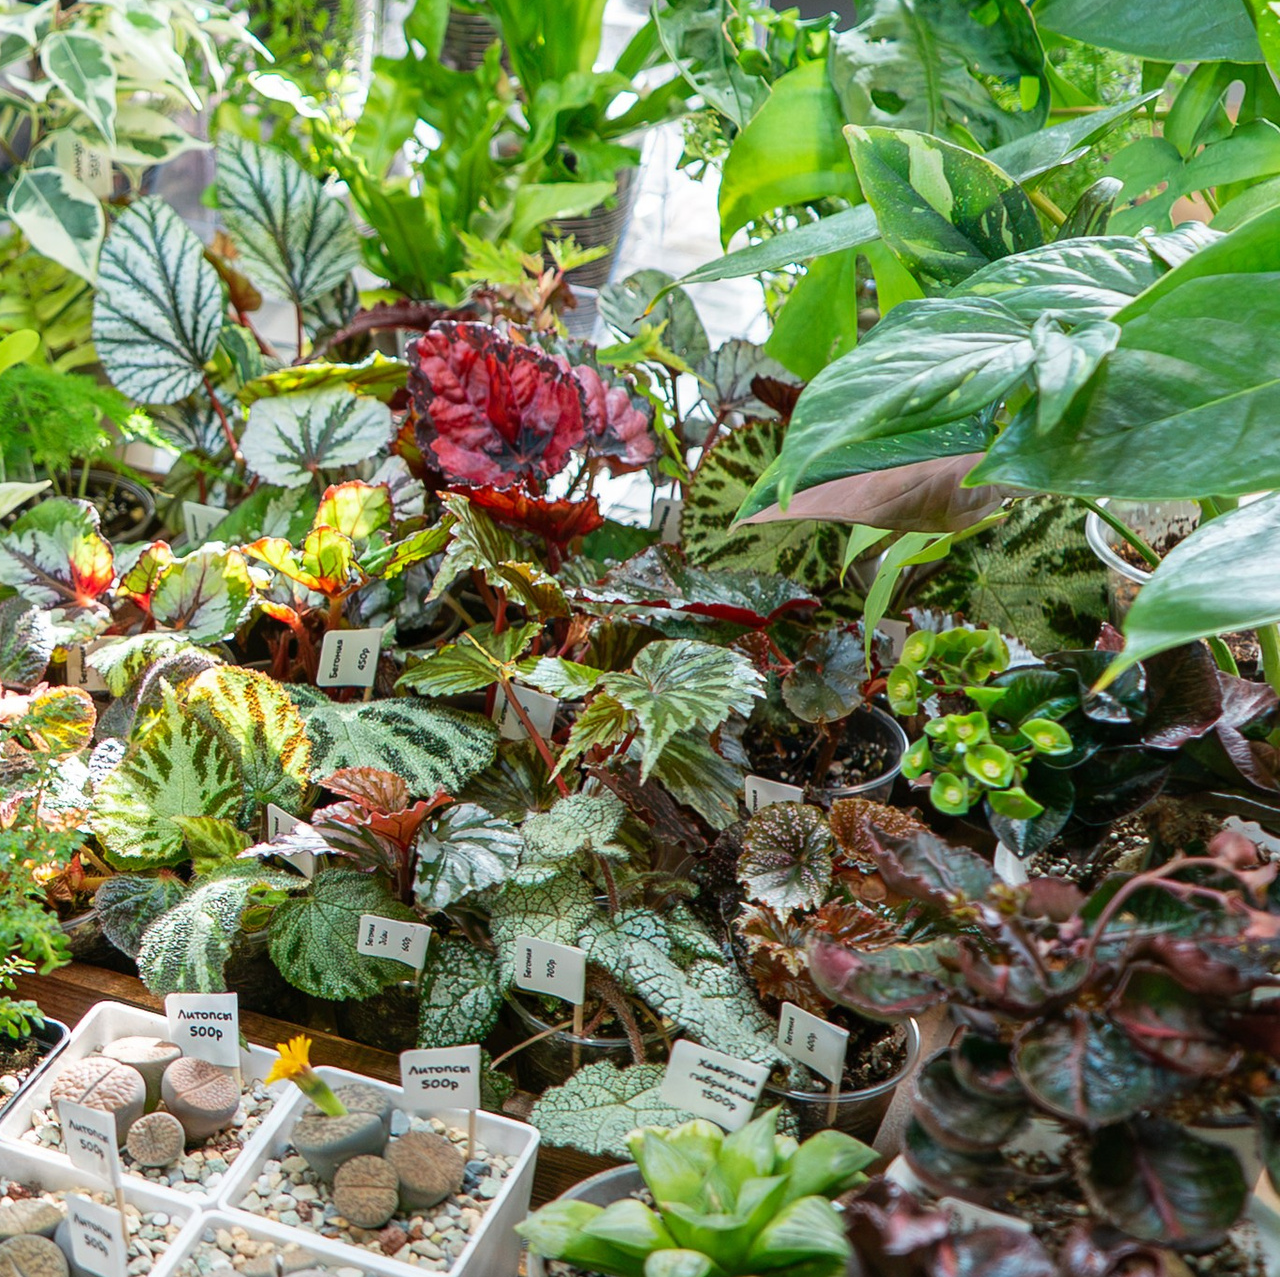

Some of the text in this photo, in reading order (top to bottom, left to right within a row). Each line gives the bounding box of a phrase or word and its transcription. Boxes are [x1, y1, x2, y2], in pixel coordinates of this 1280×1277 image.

[328, 639, 343, 679] Бегония
[357, 647, 370, 671] 450р
[365, 923, 375, 946] Бегония
[523, 948, 532, 979] Бегония
[546, 958, 557, 978] 700р
[177, 1009, 233, 1021] Литопсы
[190, 1025, 223, 1041] 500р
[784, 1016, 795, 1045] Бегония
[806, 1032, 818, 1053] 600р
[408, 1065, 471, 1075] Литопсы
[697, 1057, 757, 1087] Хавортия
[421, 1079, 459, 1091] 500р
[689, 1072, 757, 1103] гибридная
[701, 1088, 737, 1111] 1500р
[79, 1138, 105, 1159] 500р
[83, 1233, 109, 1257] 500р
